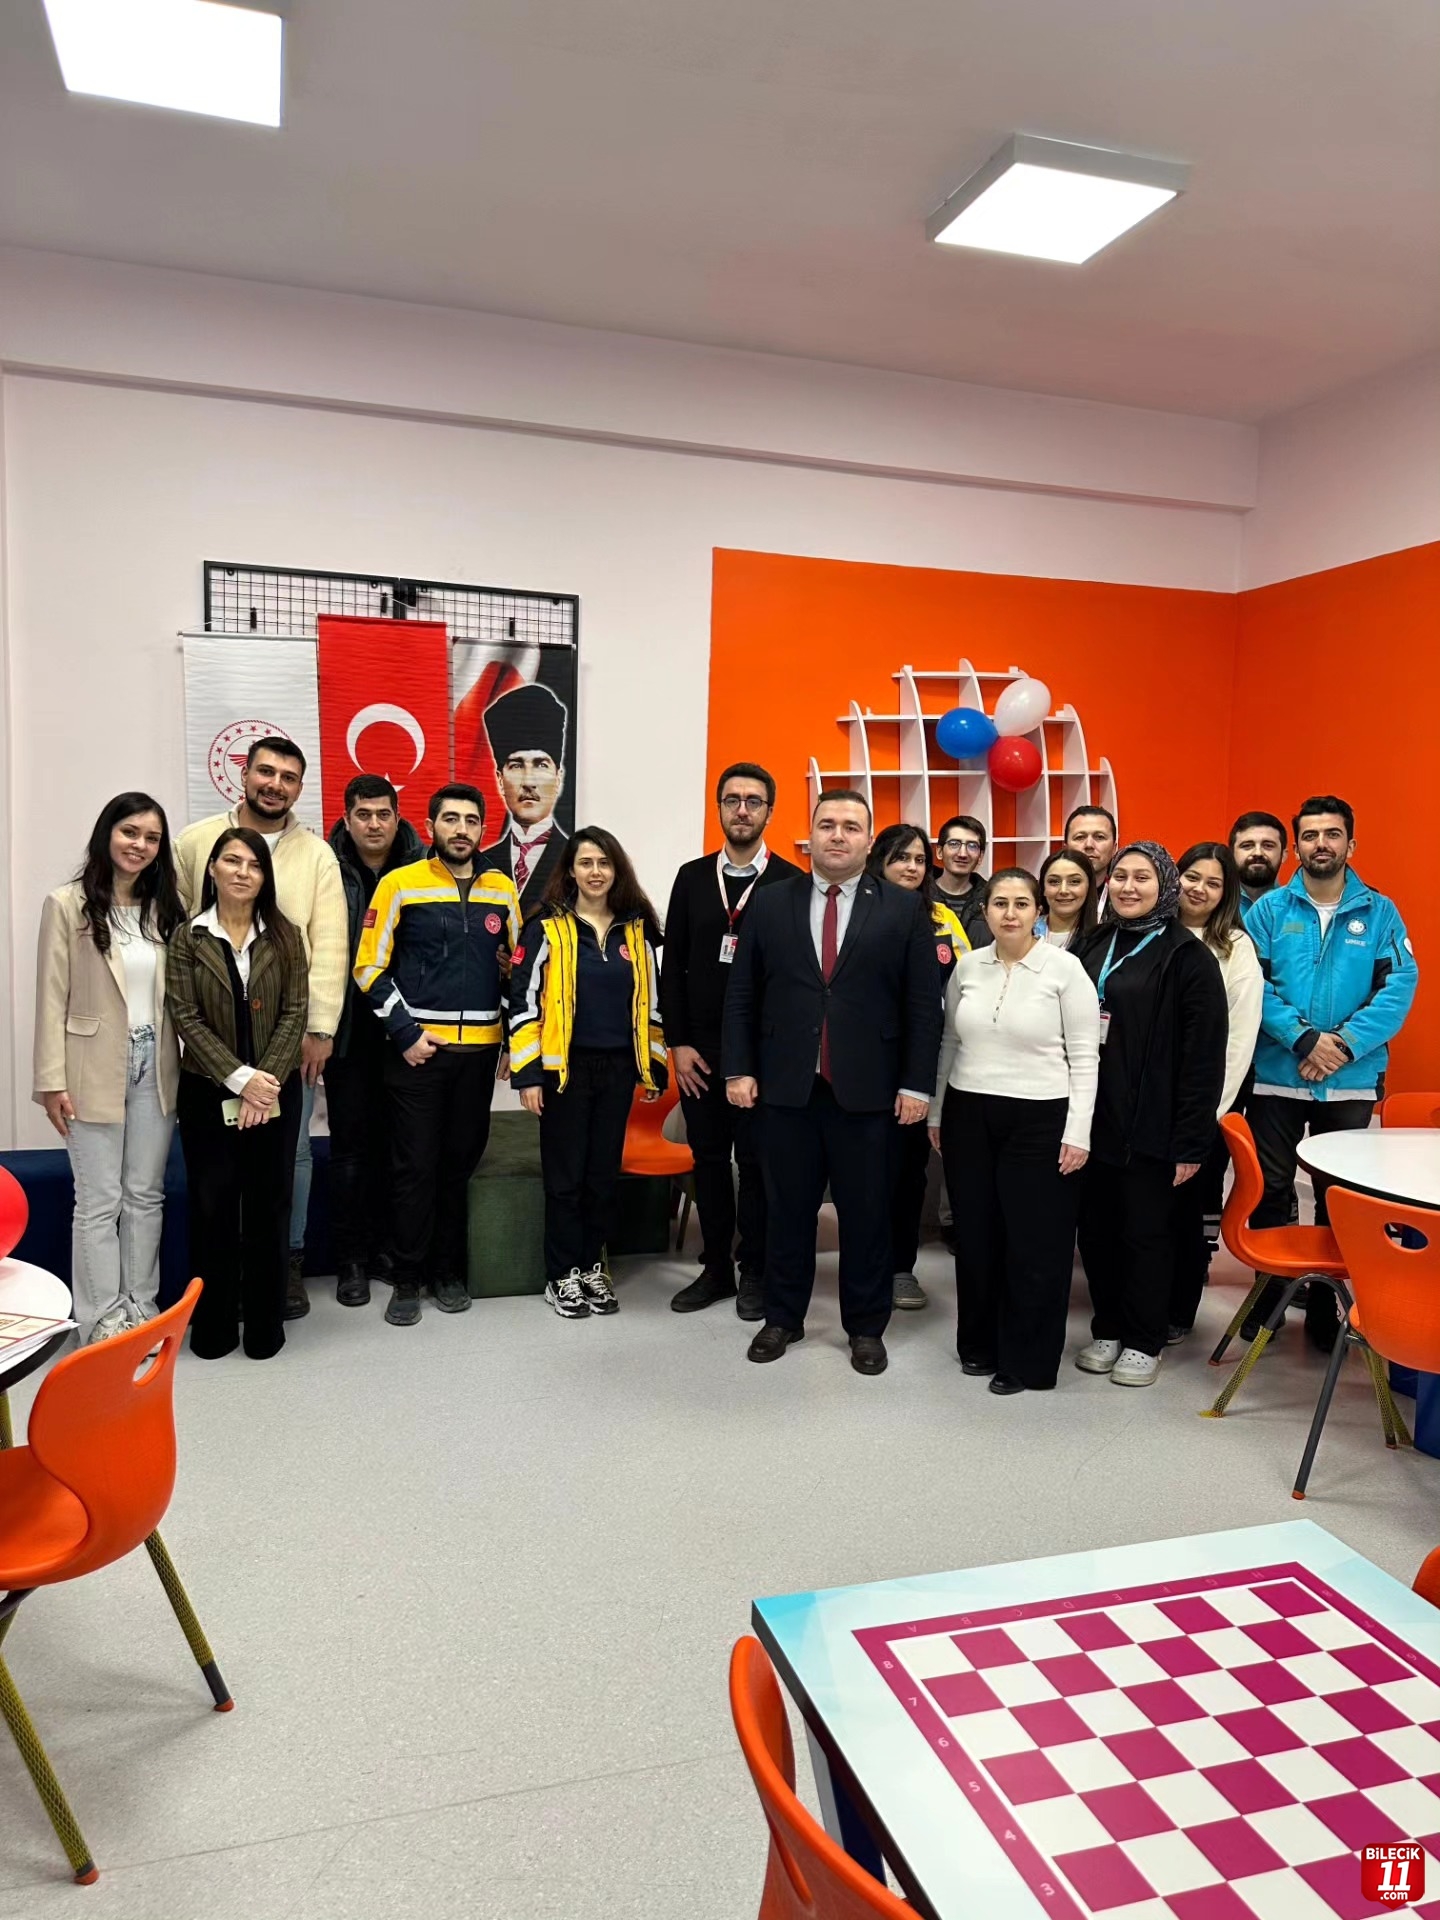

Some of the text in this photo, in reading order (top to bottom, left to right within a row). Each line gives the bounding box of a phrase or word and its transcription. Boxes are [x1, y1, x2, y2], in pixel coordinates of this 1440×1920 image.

[961, 1616, 972, 1625] B
[1063, 1601, 1075, 1609] D
[883, 1660, 1055, 1896] 8 7 6 5 4 3
